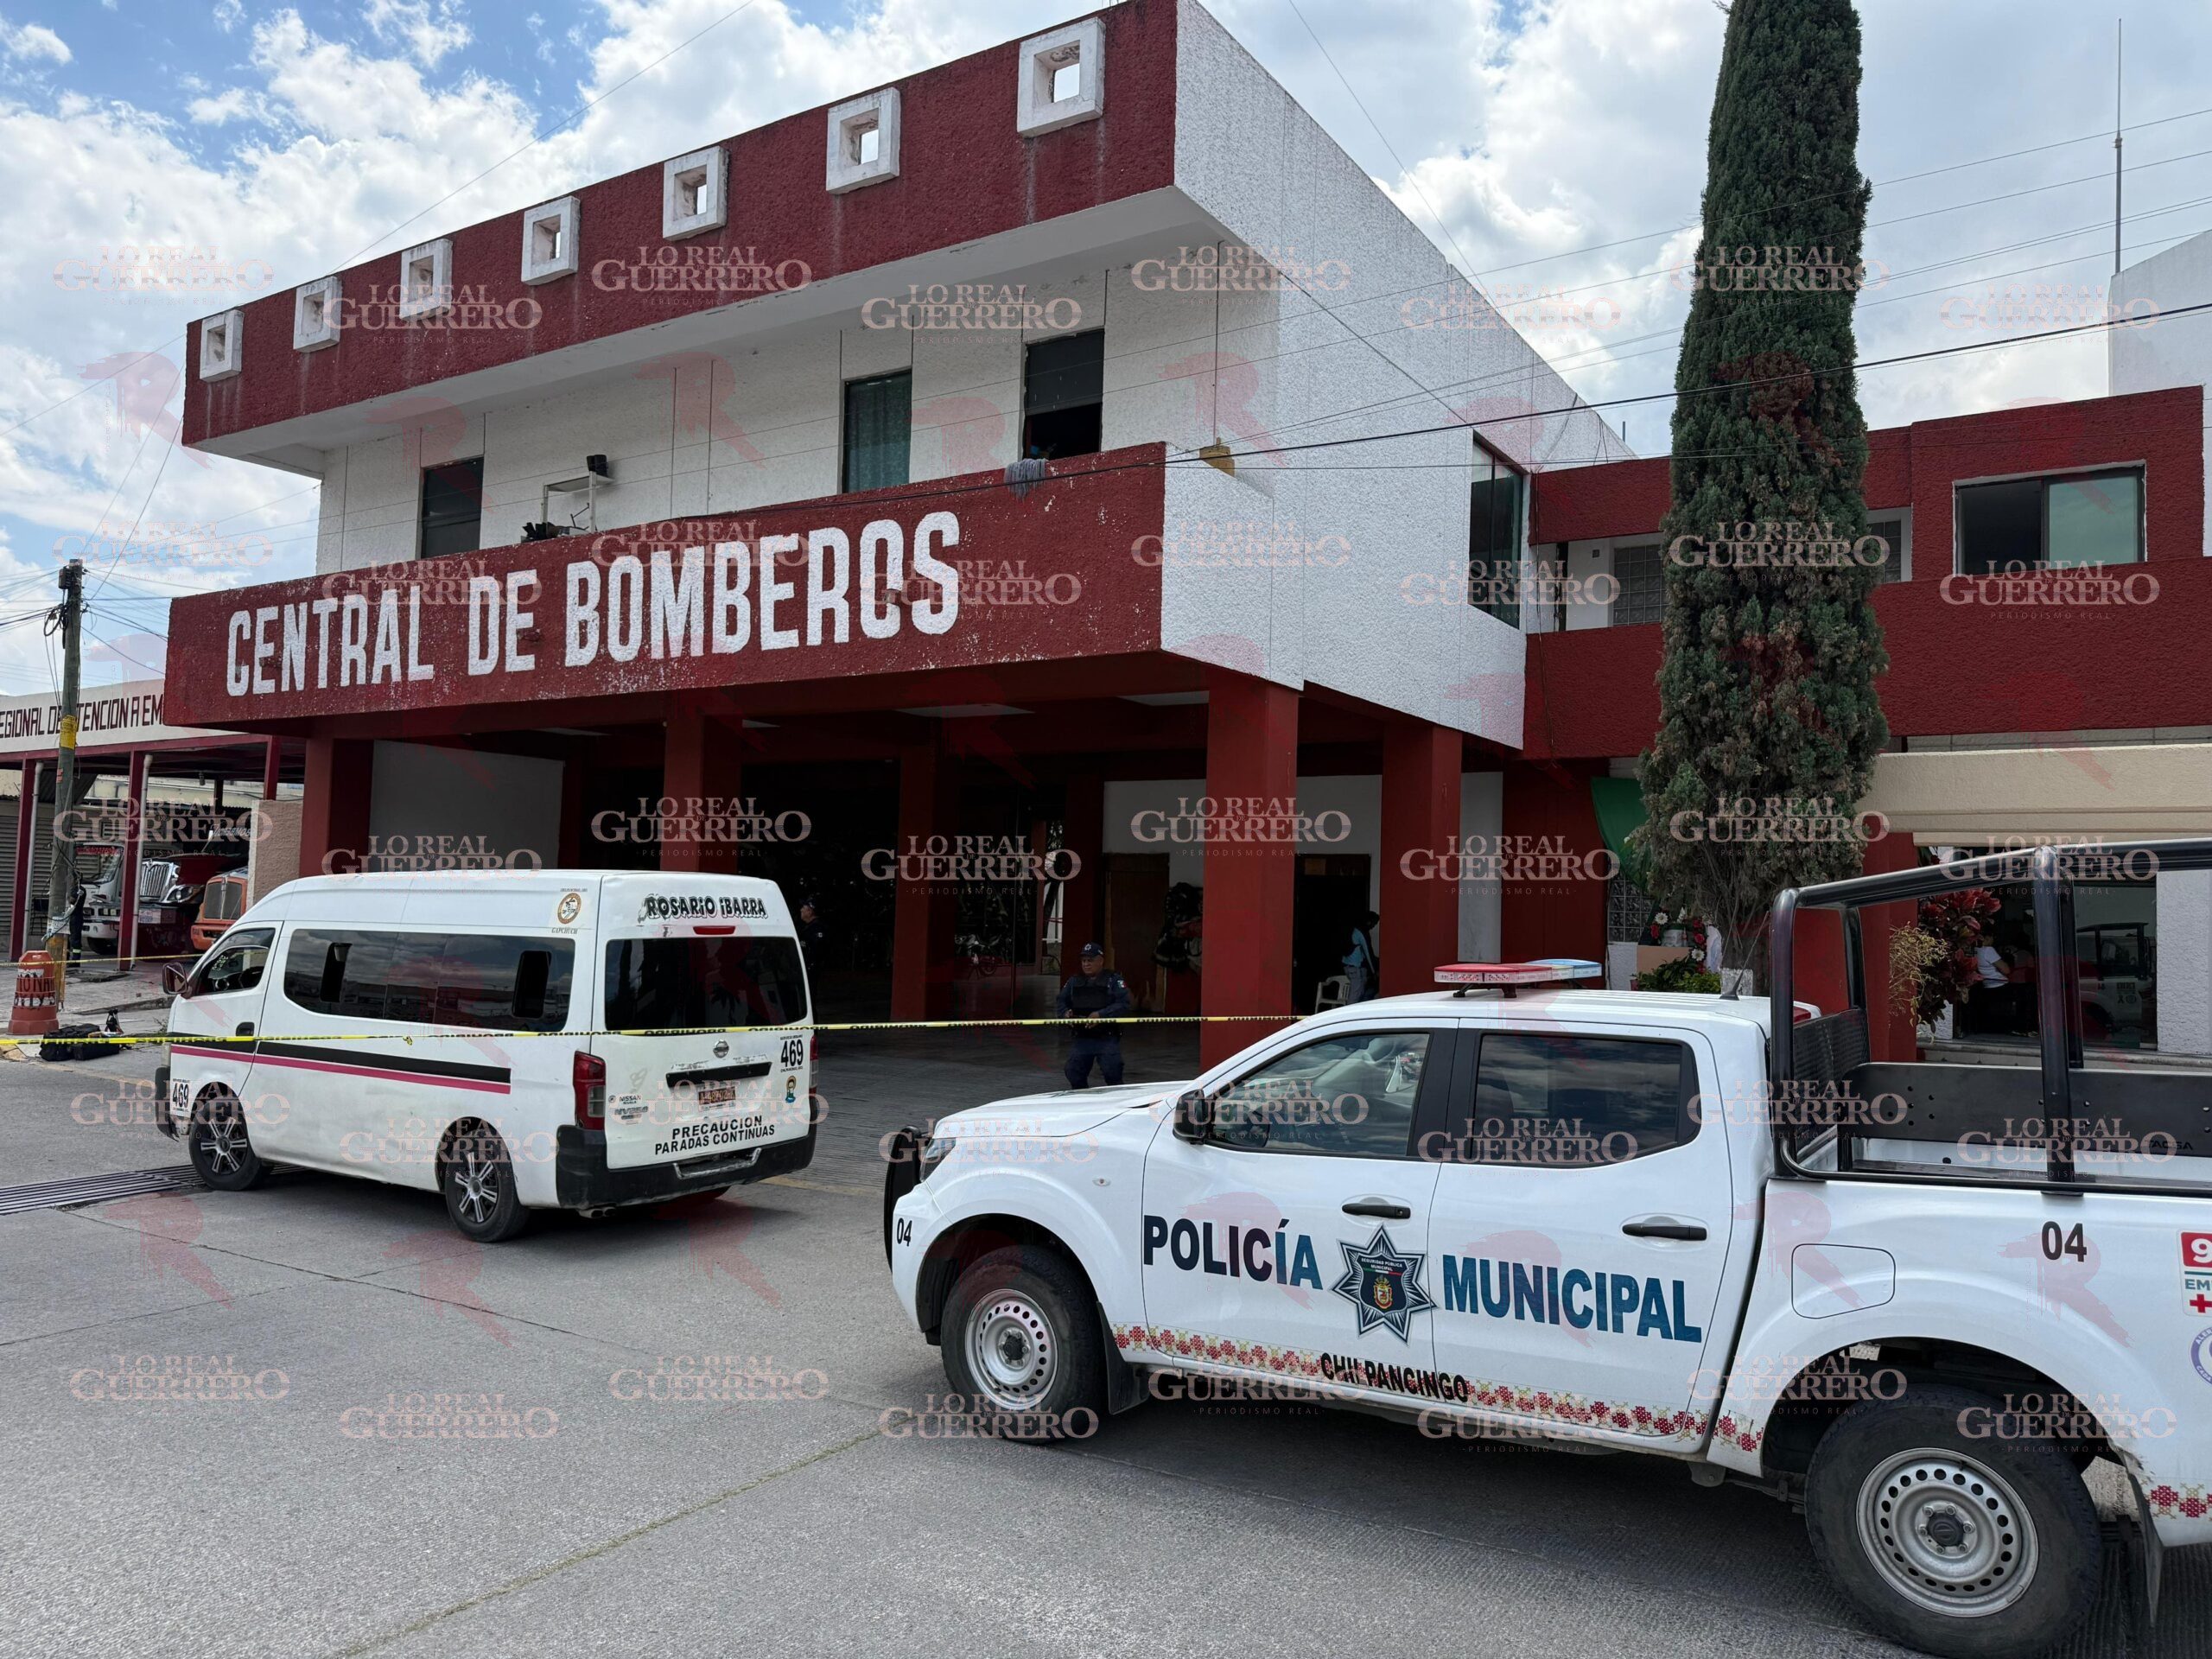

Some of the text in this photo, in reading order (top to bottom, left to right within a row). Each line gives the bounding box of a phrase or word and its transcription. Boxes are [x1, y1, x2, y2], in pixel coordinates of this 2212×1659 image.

[226, 511, 960, 696] CENTRAL DE BOMBEROS
[76, 696, 130, 732] TENCION
[130, 696, 140, 727] A
[780, 1039, 804, 1067] 469
[173, 1083, 189, 1109] 469
[655, 1124, 775, 1155] PARADAS CONTINUAS
[672, 1115, 763, 1141] PRECAUCION
[896, 1217, 912, 1248] 04
[2041, 1221, 2087, 1262] 04
[1143, 1215, 1702, 1343] POLICÍA MUNICIPAL
[2185, 1279, 2212, 1291] EM
